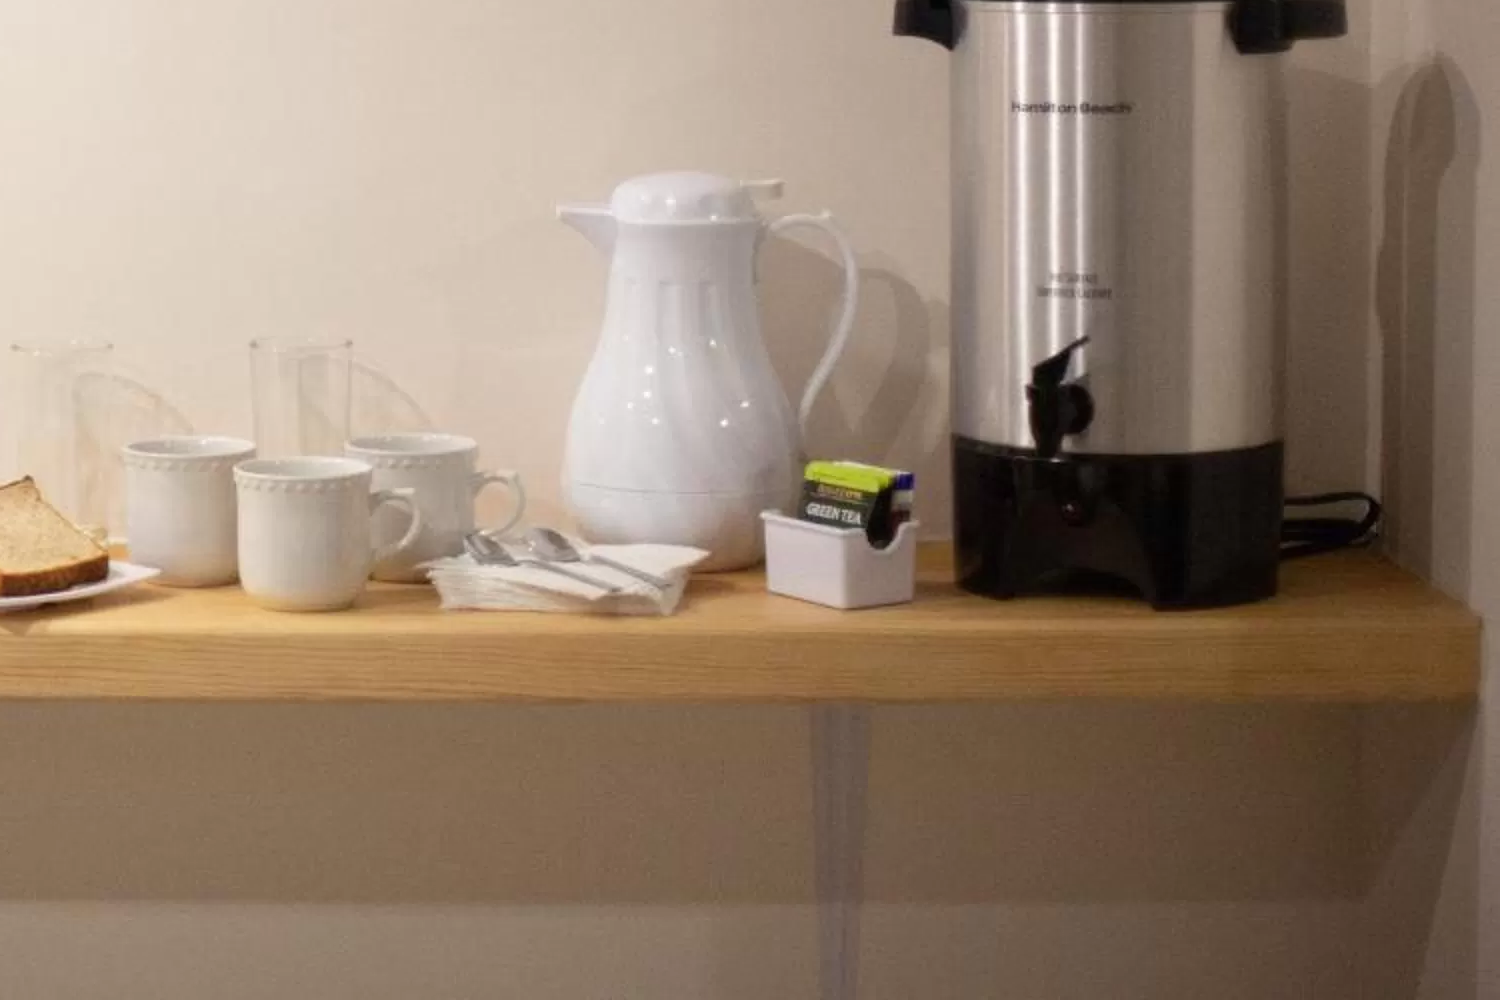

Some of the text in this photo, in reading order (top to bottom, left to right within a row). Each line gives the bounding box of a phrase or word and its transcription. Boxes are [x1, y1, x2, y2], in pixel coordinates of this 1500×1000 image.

[1011, 102, 1077, 113] Hamilton
[806, 502, 861, 525] GREEN TEA
